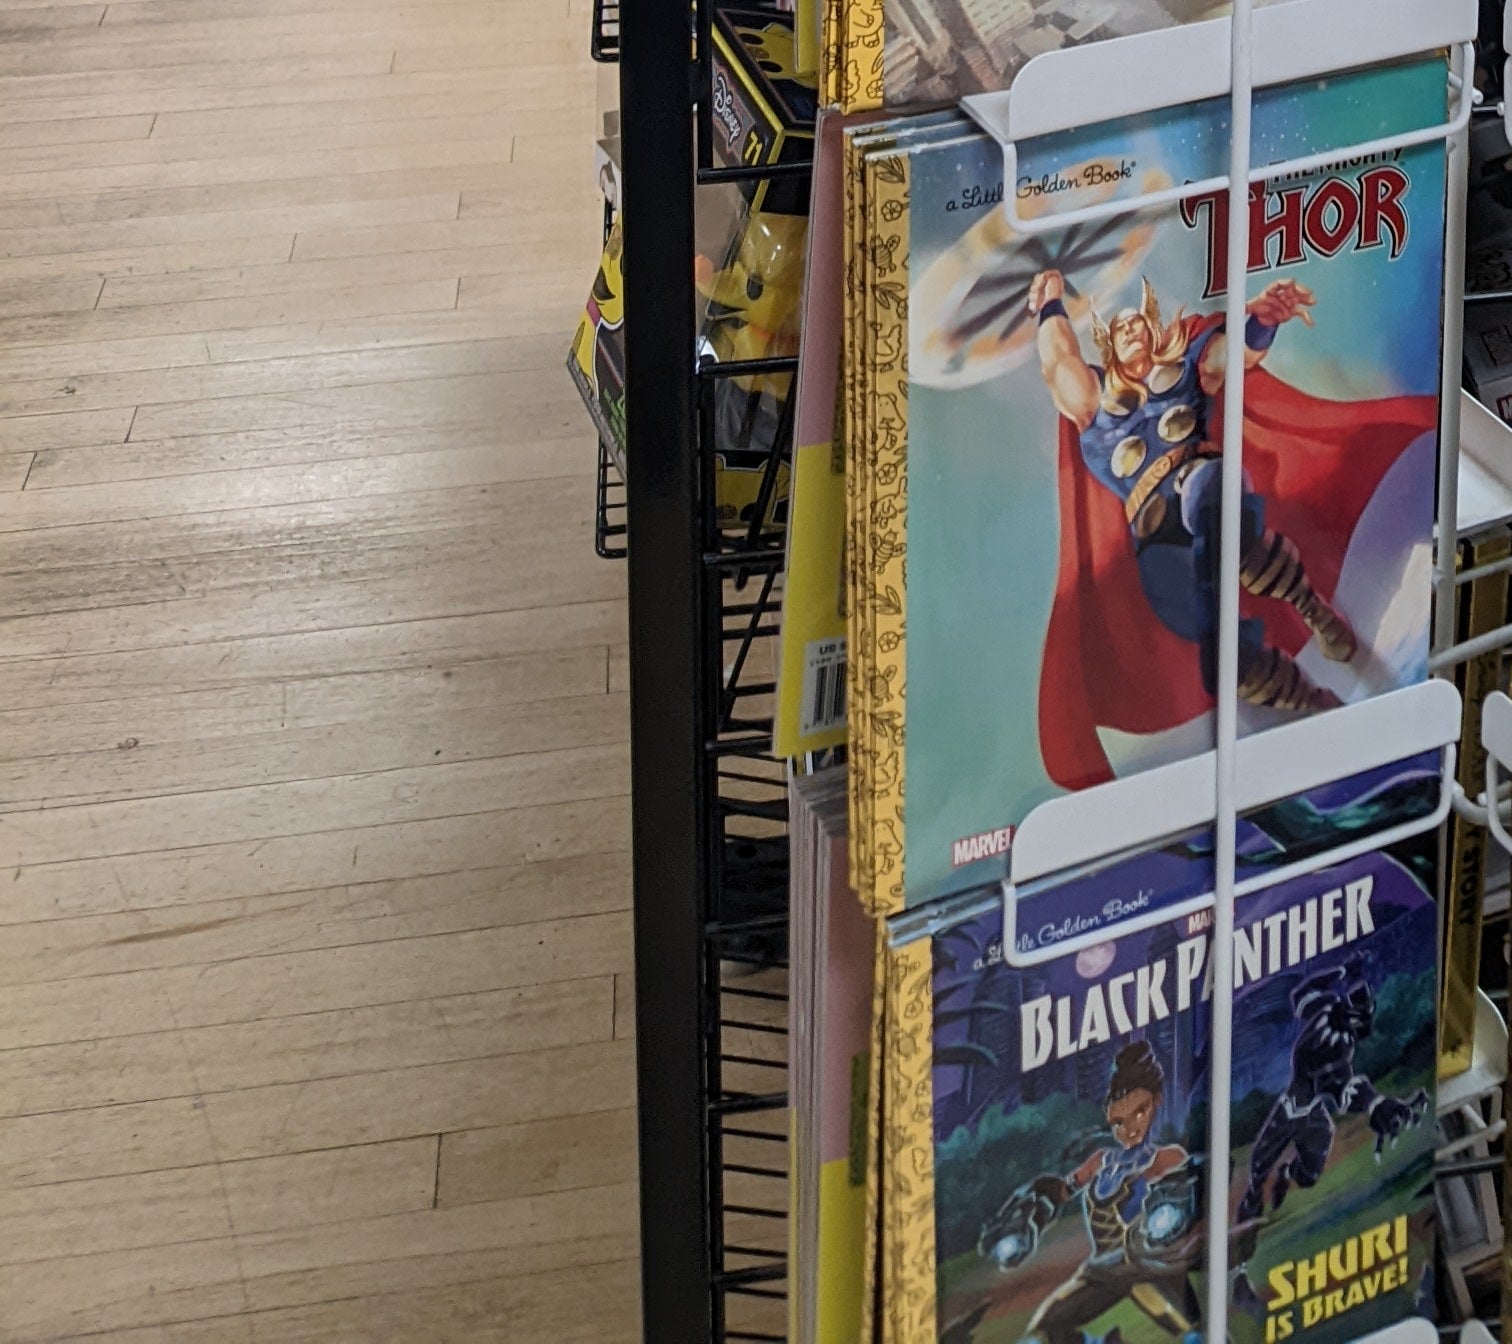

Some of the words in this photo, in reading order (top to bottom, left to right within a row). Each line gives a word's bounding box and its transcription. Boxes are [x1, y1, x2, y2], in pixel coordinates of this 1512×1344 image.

[713, 72, 744, 154] Disney
[744, 130, 763, 166] 71
[945, 199, 959, 213] a
[961, 183, 1005, 211] Littl
[1083, 163, 1134, 189] Book
[1179, 165, 1410, 299] THOR
[1037, 916, 1101, 947] Golden
[1103, 891, 1149, 924] Book
[1020, 959, 1169, 1073] BLACK
[1265, 1308, 1293, 1344] IS
[1302, 1256, 1408, 1327] BRAVE!
[1267, 1213, 1409, 1312] SHURI
